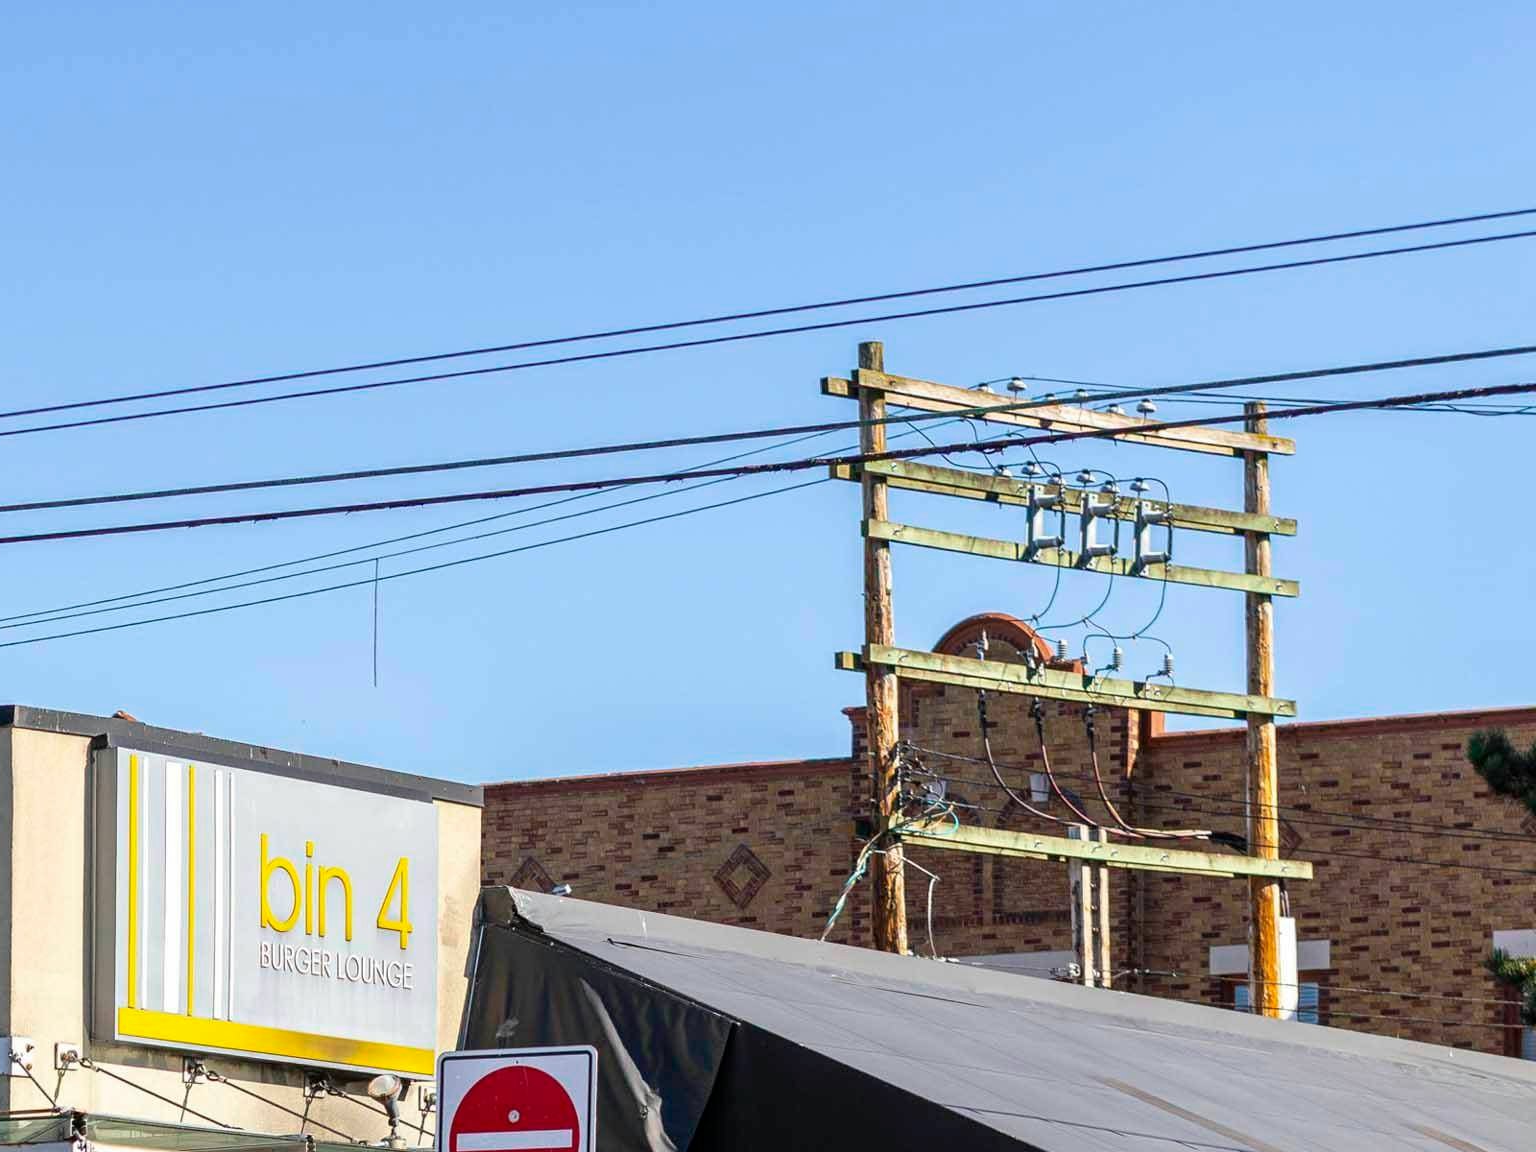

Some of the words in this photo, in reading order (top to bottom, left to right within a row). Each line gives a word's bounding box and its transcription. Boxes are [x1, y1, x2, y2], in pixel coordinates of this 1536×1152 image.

[260, 833, 353, 942] bin
[376, 857, 413, 950] 4
[260, 942, 331, 978] BURGER
[336, 953, 414, 990] LOUNGE
